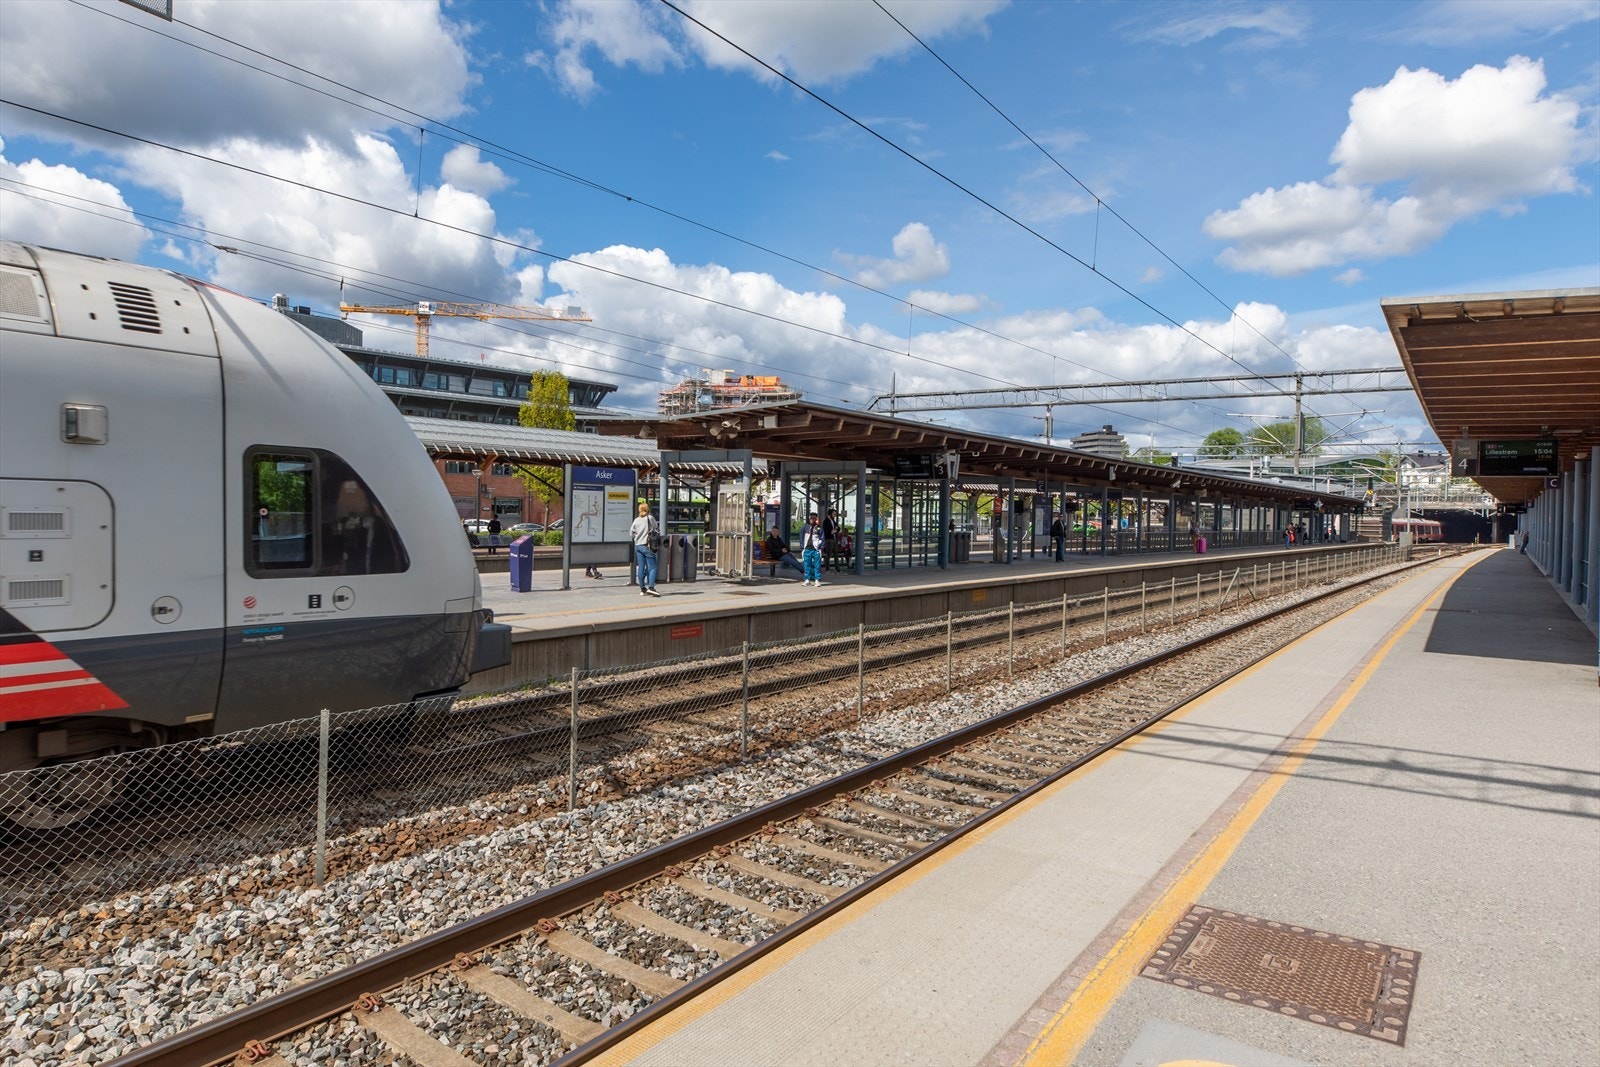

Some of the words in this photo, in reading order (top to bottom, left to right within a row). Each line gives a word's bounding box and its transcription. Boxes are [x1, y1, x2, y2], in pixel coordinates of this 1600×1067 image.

[1458, 458, 1468, 469] 4
[595, 470, 613, 479] Asker
[770, 466, 776, 475] 2
[938, 465, 944, 475] 3
[1549, 479, 1558, 487] C
